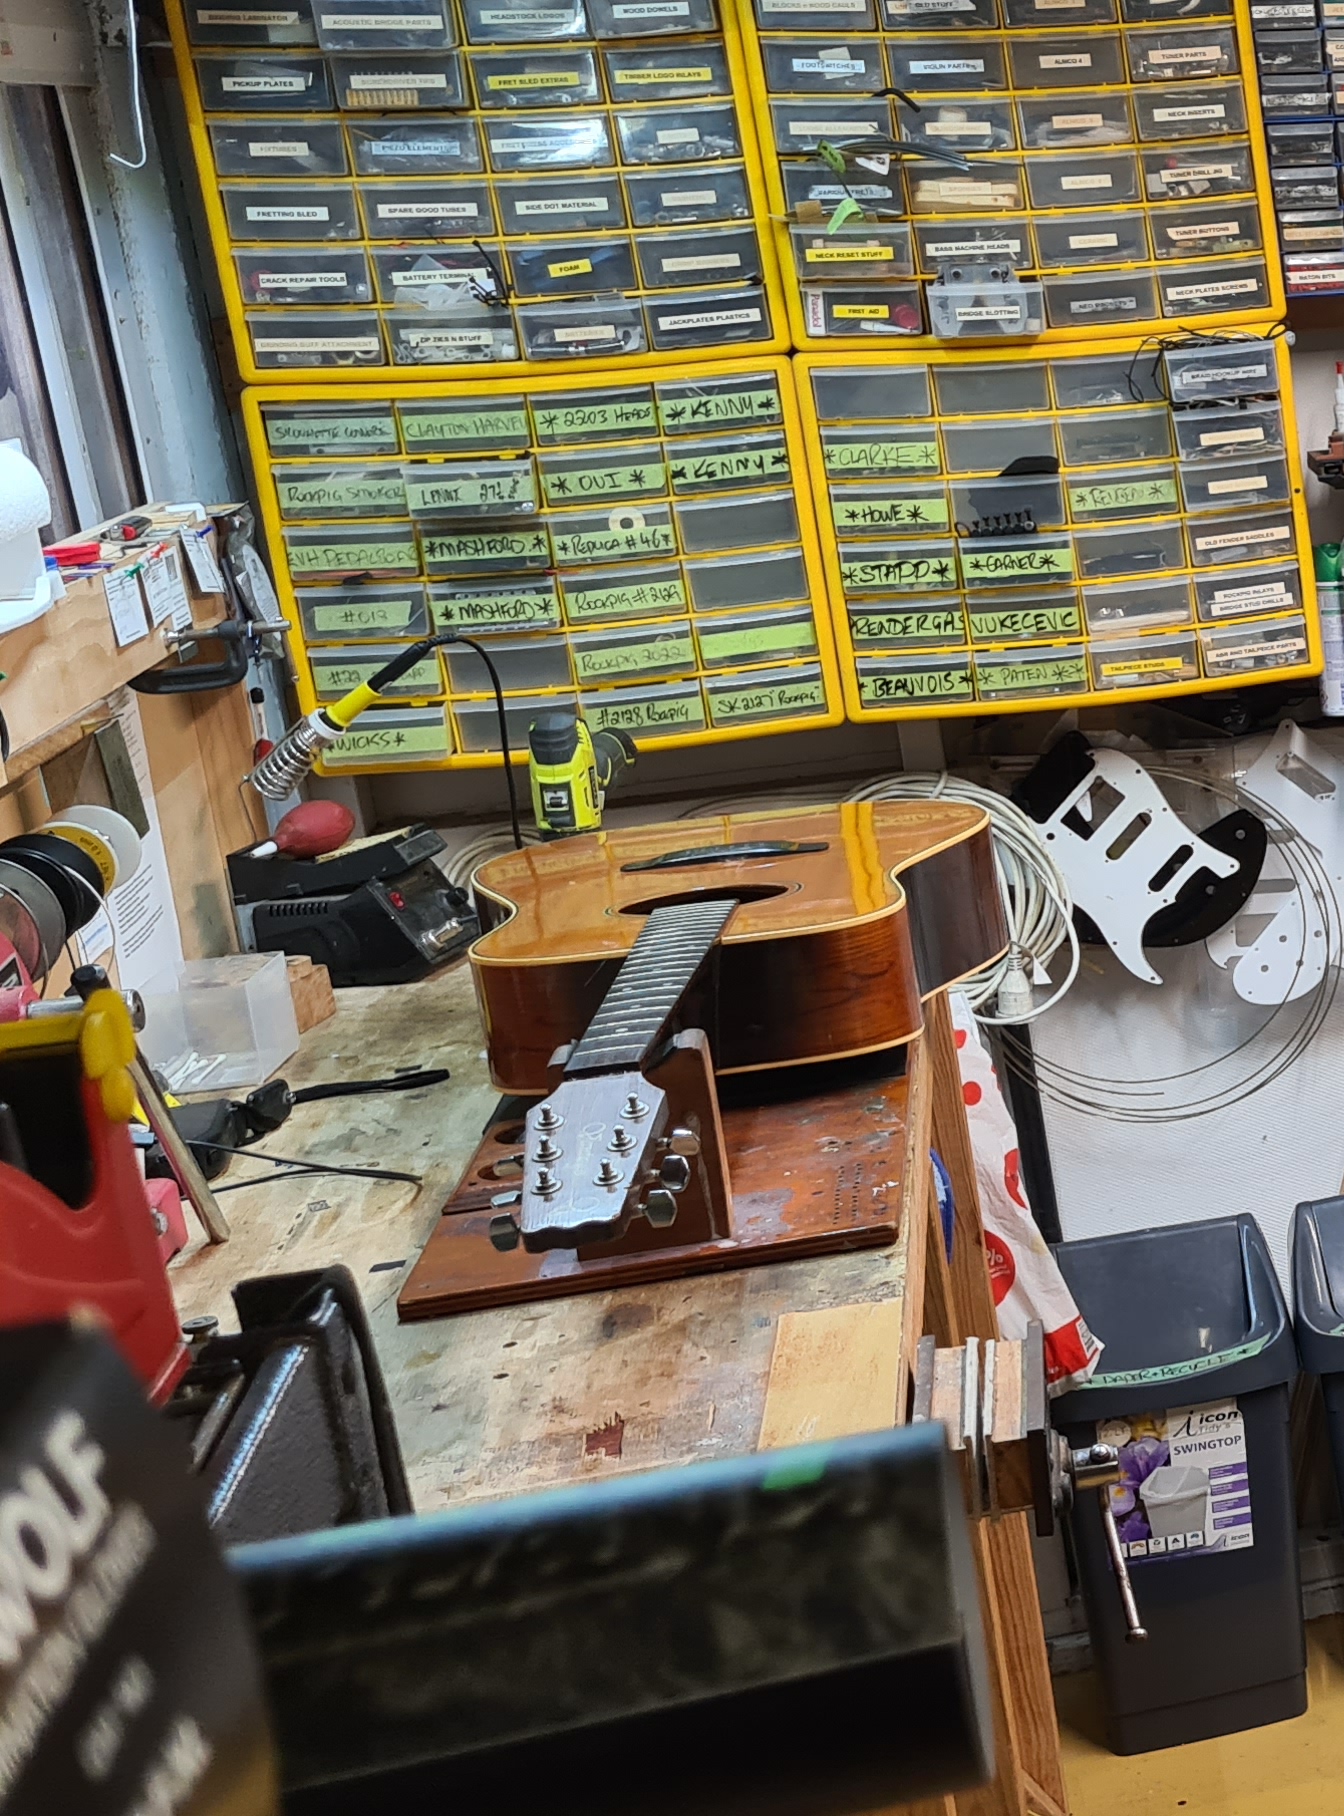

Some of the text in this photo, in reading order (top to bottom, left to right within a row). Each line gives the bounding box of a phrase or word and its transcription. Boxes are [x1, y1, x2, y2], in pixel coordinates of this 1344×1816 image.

[333, 18, 372, 26] ACOUSTIC
[1185, 51, 1207, 59] PARTS
[539, 76, 569, 84] EXTRAS
[652, 71, 674, 79] LOGO
[232, 80, 294, 88] PICKUP PLATES
[415, 206, 439, 214] GOOD
[543, 202, 559, 210] DOT
[561, 201, 597, 209] MATERIAL
[986, 242, 1010, 250] HEADS
[860, 250, 883, 258] STUFF
[559, 264, 580, 273] FOAM
[261, 275, 346, 285] CRACK REPAIR TOOLS
[402, 273, 437, 282] BATTERY
[1176, 288, 1192, 296] NECK
[1194, 286, 1220, 294] PLATES
[810, 294, 822, 328] Panadol
[847, 308, 865, 316] FIRST
[669, 312, 750, 326] JACKPLATES PLASTICS
[691, 395, 754, 417] KENNY
[564, 405, 652, 426] 2203 HEADS
[406, 420, 470, 438] CLAYTON
[839, 444, 918, 466] CLARKE
[694, 454, 766, 480] KENNY
[578, 472, 624, 491] OUI
[861, 504, 906, 523] HOWE
[625, 529, 661, 550] #46
[436, 536, 526, 560] MASHFORD
[986, 552, 1042, 572] GARNER
[459, 599, 535, 623] MASHFORD
[973, 611, 1077, 634] VUKECEVIC
[1276, 642, 1297, 650] PARTS
[1143, 661, 1165, 669] STUDS
[1002, 665, 1050, 685] PATEN
[873, 671, 955, 698] BEAUVOIS
[595, 706, 643, 728] #2128
[336, 731, 394, 750] WICKS
[1199, 1411, 1239, 1425] icon
[1200, 1422, 1231, 1435] Tidy's
[1173, 1436, 1242, 1456] SWINGTOP
